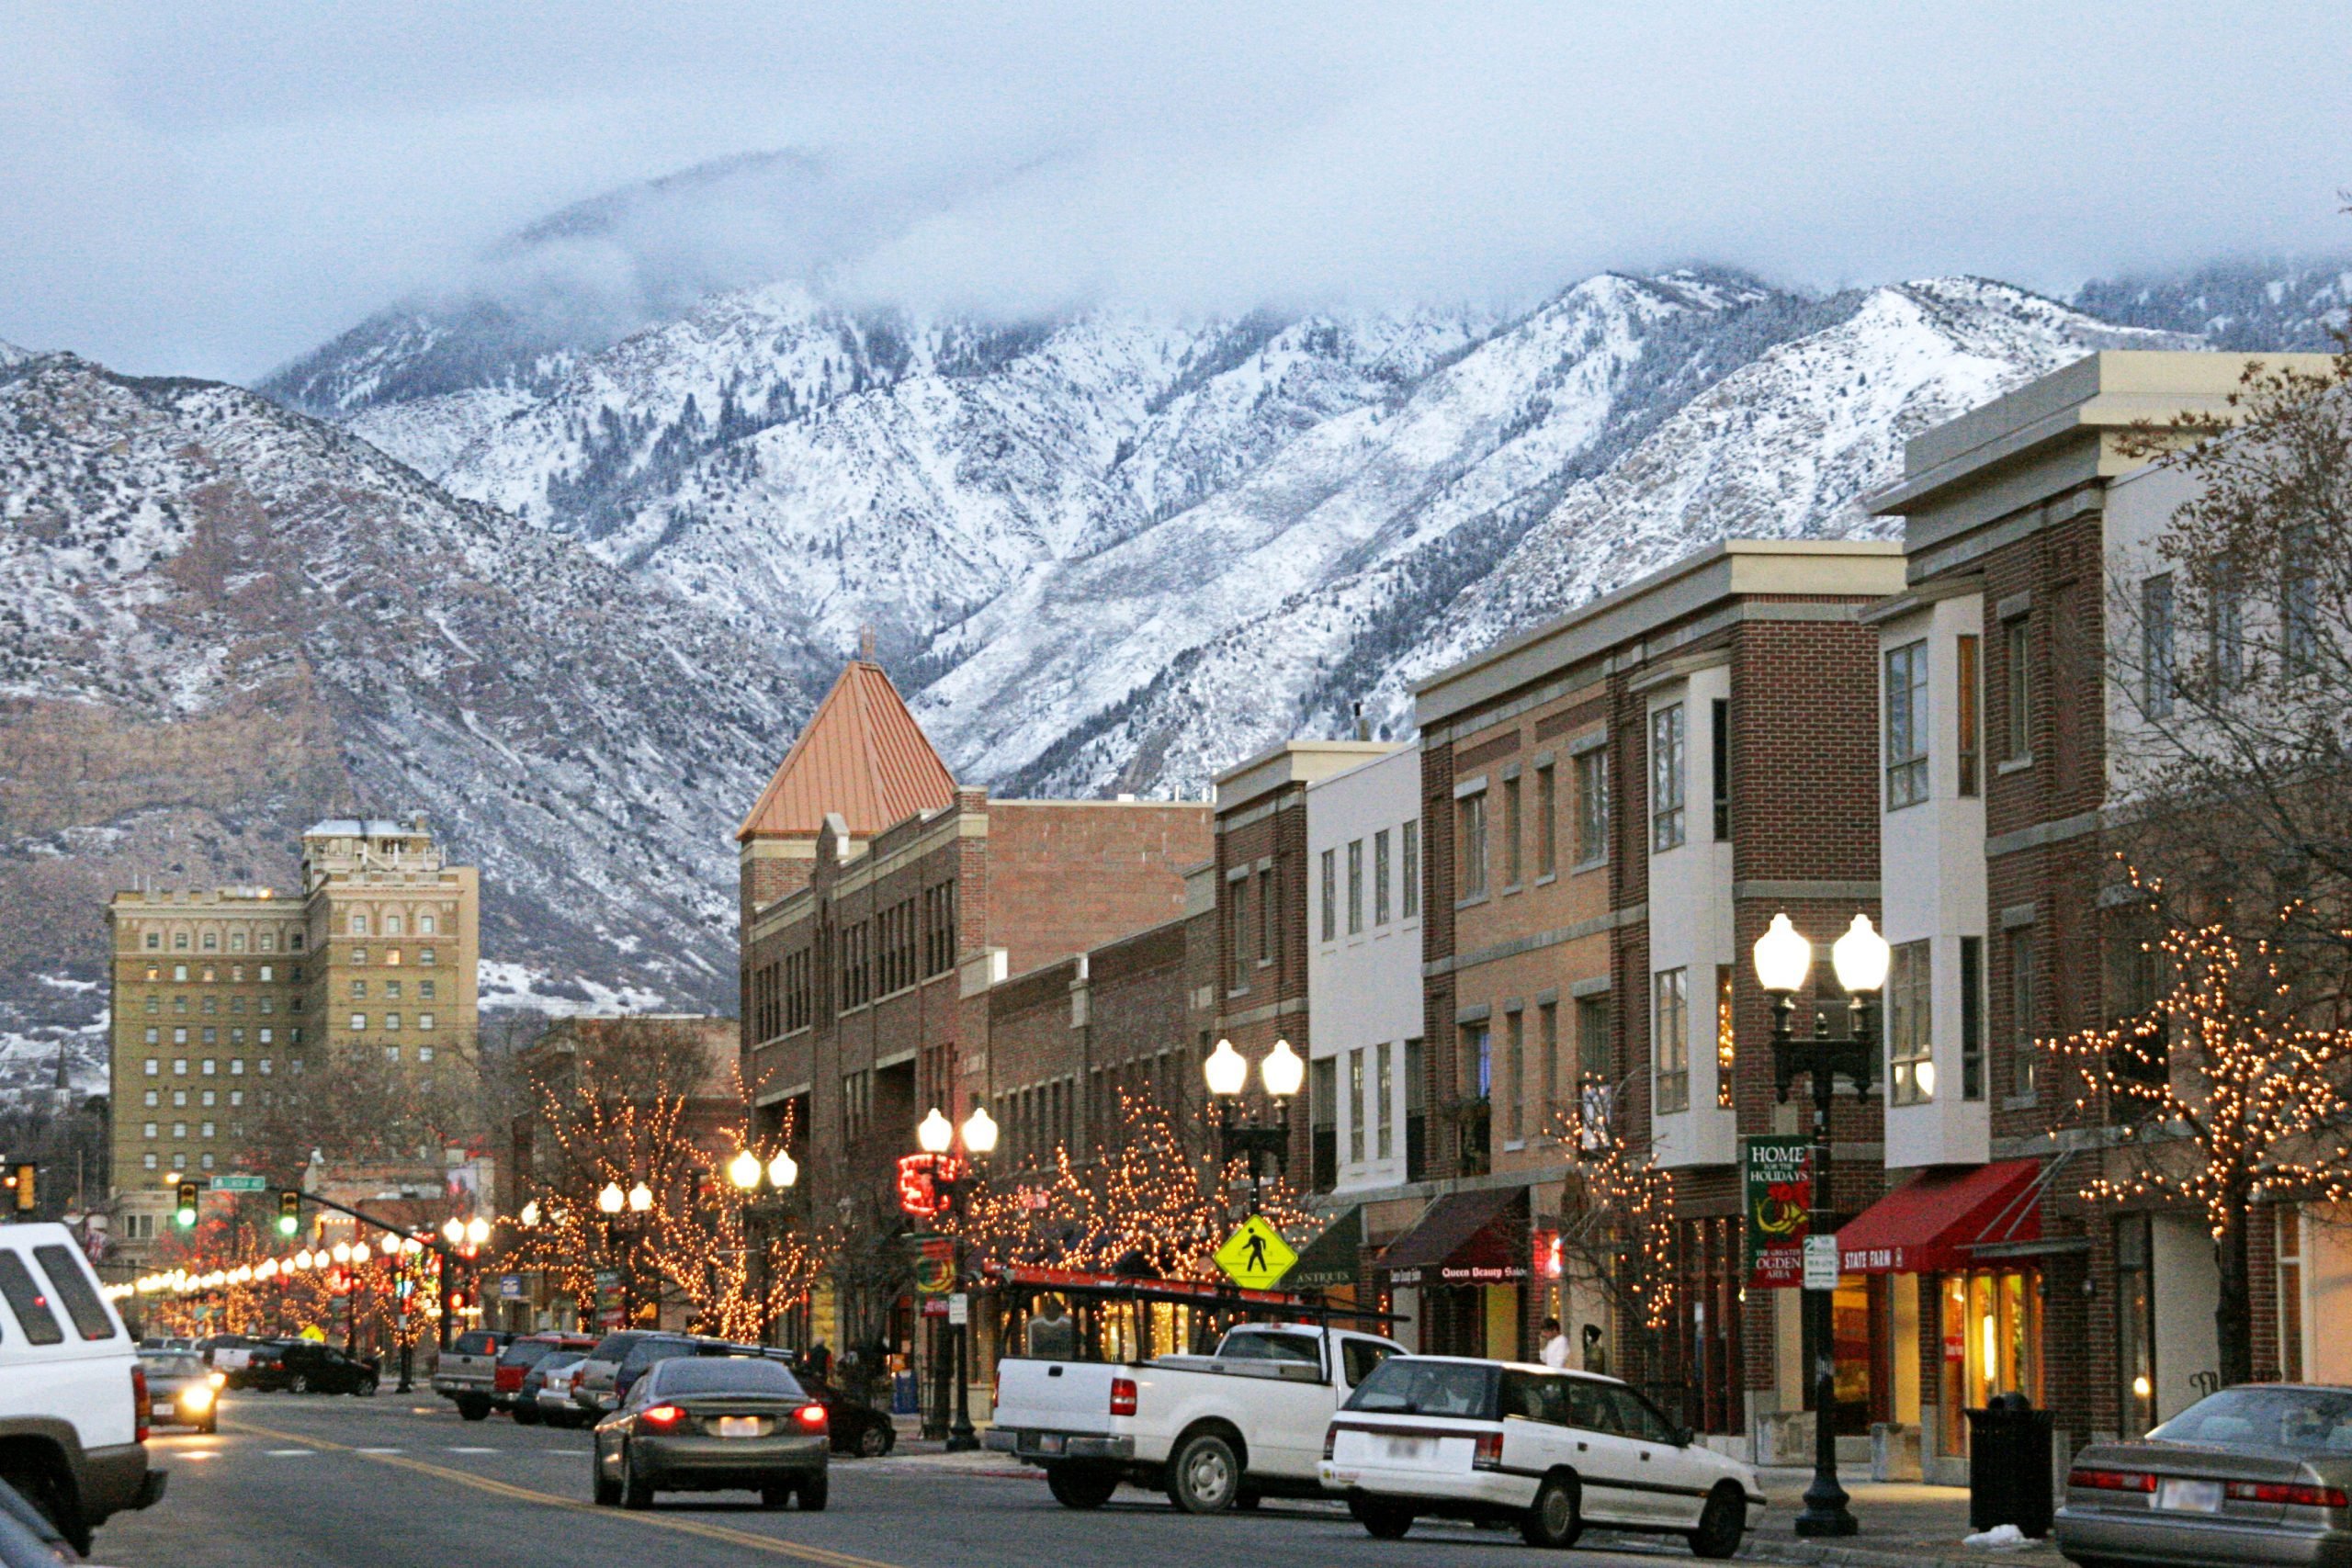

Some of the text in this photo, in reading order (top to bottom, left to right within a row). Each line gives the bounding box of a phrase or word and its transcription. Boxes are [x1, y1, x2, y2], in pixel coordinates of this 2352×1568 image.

[1751, 1145, 1805, 1163] HOME
[1750, 1170, 1808, 1182] HOLIDAYS
[1756, 1257, 1801, 1270] OGDEN
[1845, 1251, 1867, 1269] STATE
[1870, 1249, 1891, 1267] FARM
[1442, 1268, 1470, 1278] Queen
[1472, 1267, 1502, 1279] Beauty
[1766, 1269, 1791, 1280] AREA
